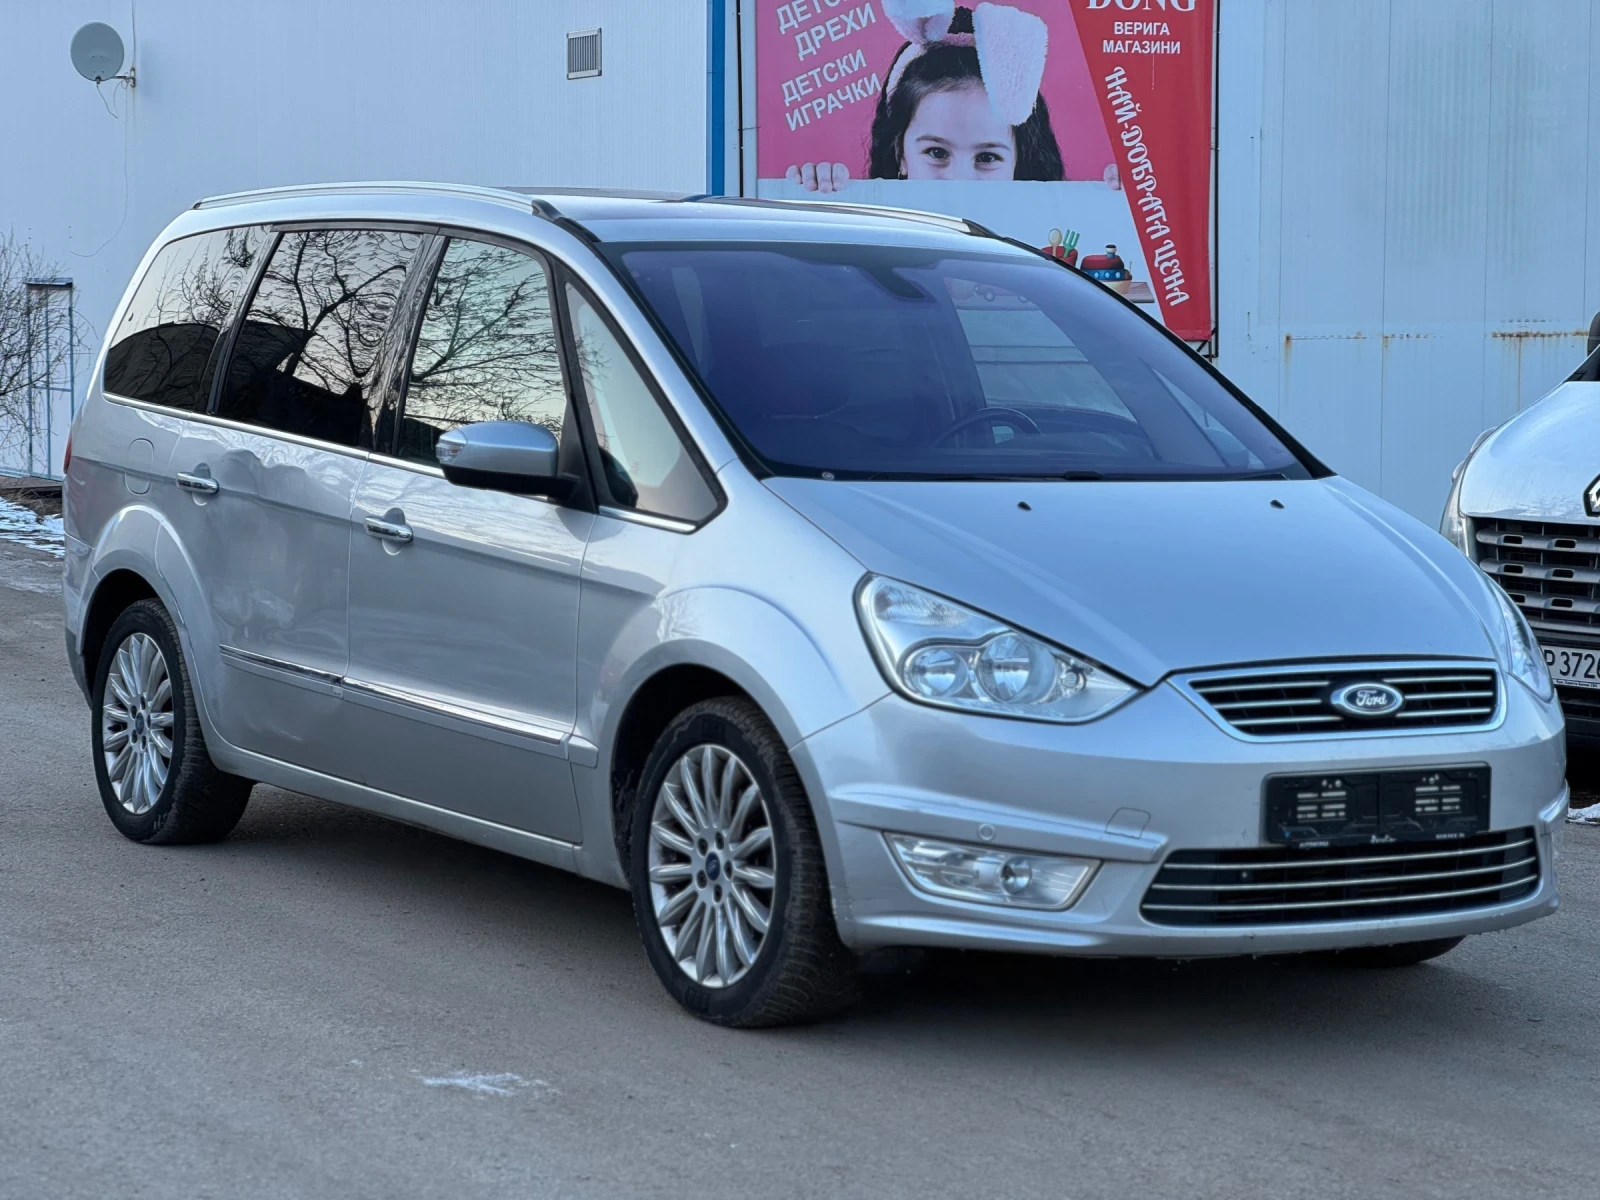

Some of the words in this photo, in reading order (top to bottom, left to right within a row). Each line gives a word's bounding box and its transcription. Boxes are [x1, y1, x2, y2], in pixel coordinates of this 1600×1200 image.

[794, 2, 877, 61] ДРЕХИ
[1102, 39, 1181, 54] МАГАЗИНИ
[1114, 21, 1170, 35] ВЕРИГА
[781, 48, 867, 107] ДЕТСКИ
[785, 73, 882, 131] ИГРАЧКИ
[1154, 239, 1190, 307] ЦЕНА
[1559, 651, 1600, 679] 372
[1356, 689, 1388, 706] Ford
